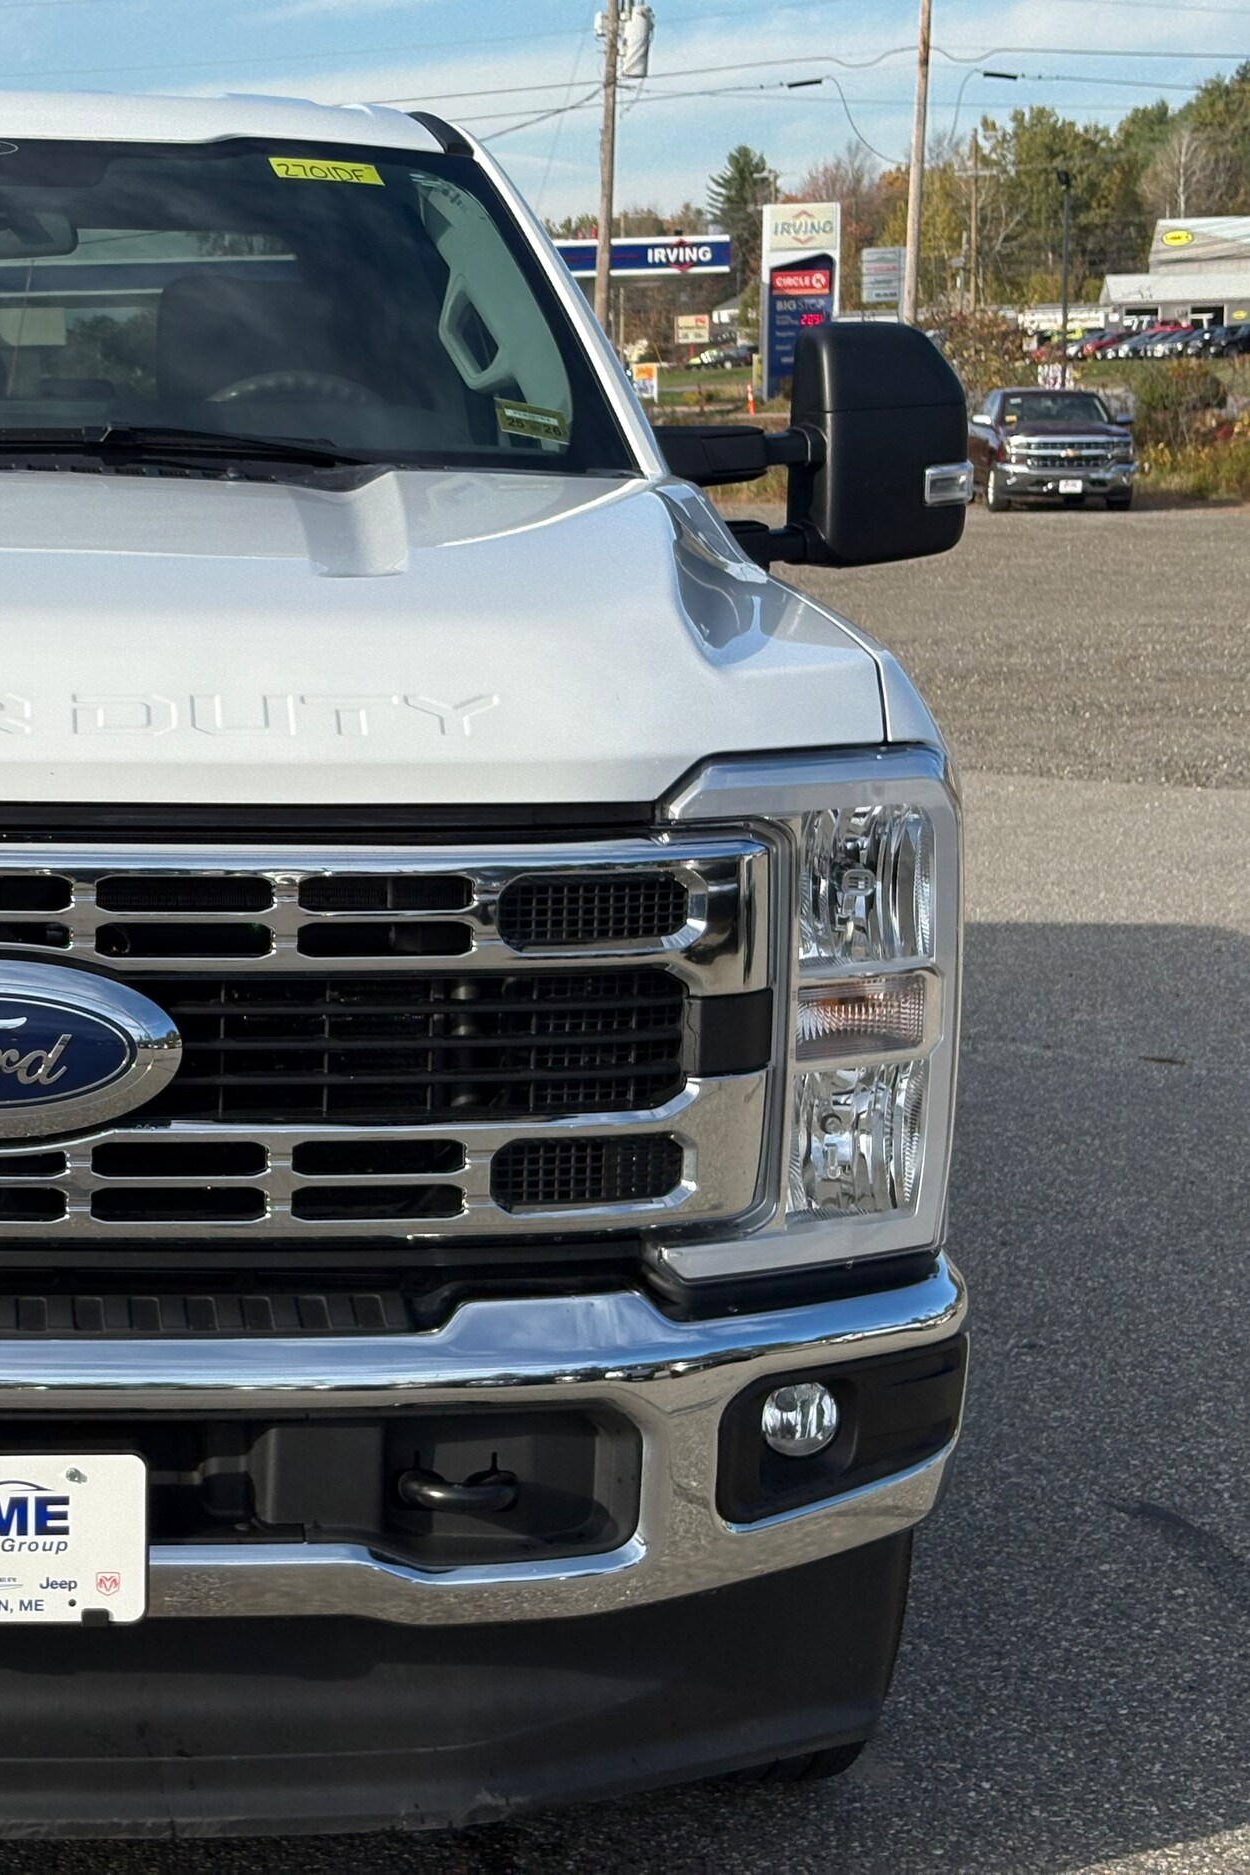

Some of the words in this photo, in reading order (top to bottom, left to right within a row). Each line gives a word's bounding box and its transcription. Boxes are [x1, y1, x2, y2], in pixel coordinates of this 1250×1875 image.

[773, 220, 834, 236] IRVING
[647, 246, 712, 263] IRVING
[775, 276, 810, 287] CIRCLE
[506, 417, 525, 429] 25
[543, 424, 562, 436] 26
[71, 693, 500, 737] DUTY
[1, 1538, 68, 1555] Group
[40, 1577, 78, 1592] Jeep
[19, 1599, 45, 1612] ME
